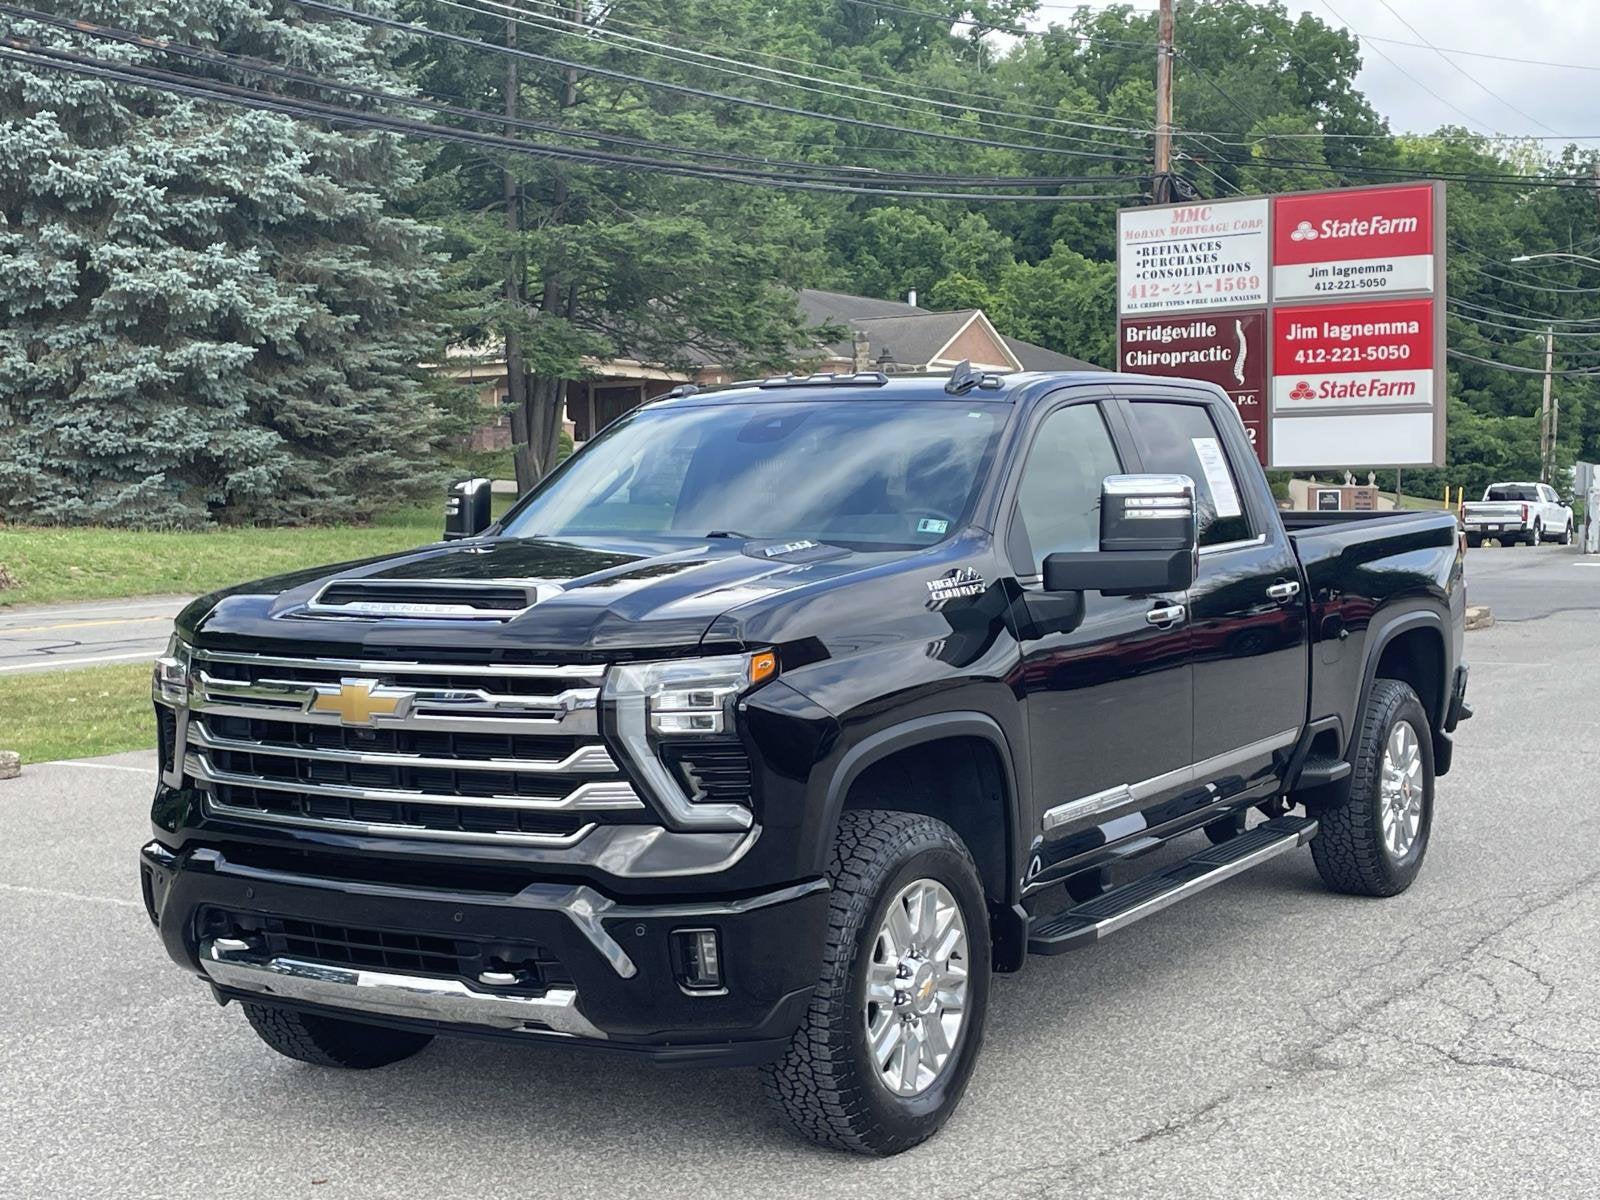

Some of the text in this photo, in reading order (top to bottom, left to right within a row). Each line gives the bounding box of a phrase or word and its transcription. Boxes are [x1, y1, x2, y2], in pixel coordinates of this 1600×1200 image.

[1172, 207, 1212, 223] MMC
[1170, 221, 1229, 236] MORTGAGE
[1142, 240, 1222, 257] REFINANCES
[1142, 253, 1218, 268] PURCHASES
[1142, 262, 1251, 280] CONSOLIDATIONS
[1308, 267, 1328, 278] Jim
[1127, 275, 1260, 299] 412-221-1569
[1314, 278, 1387, 291] 412-221-5050
[1140, 301, 1163, 309] CREDIT
[1210, 296, 1228, 304] LOAN
[1230, 294, 1261, 303] ANALYSIS
[1126, 322, 1217, 344] Bridgeville
[1285, 323, 1318, 341] Jim
[1125, 346, 1232, 367] Chiropractic
[1295, 344, 1410, 364] 412-221-5050
